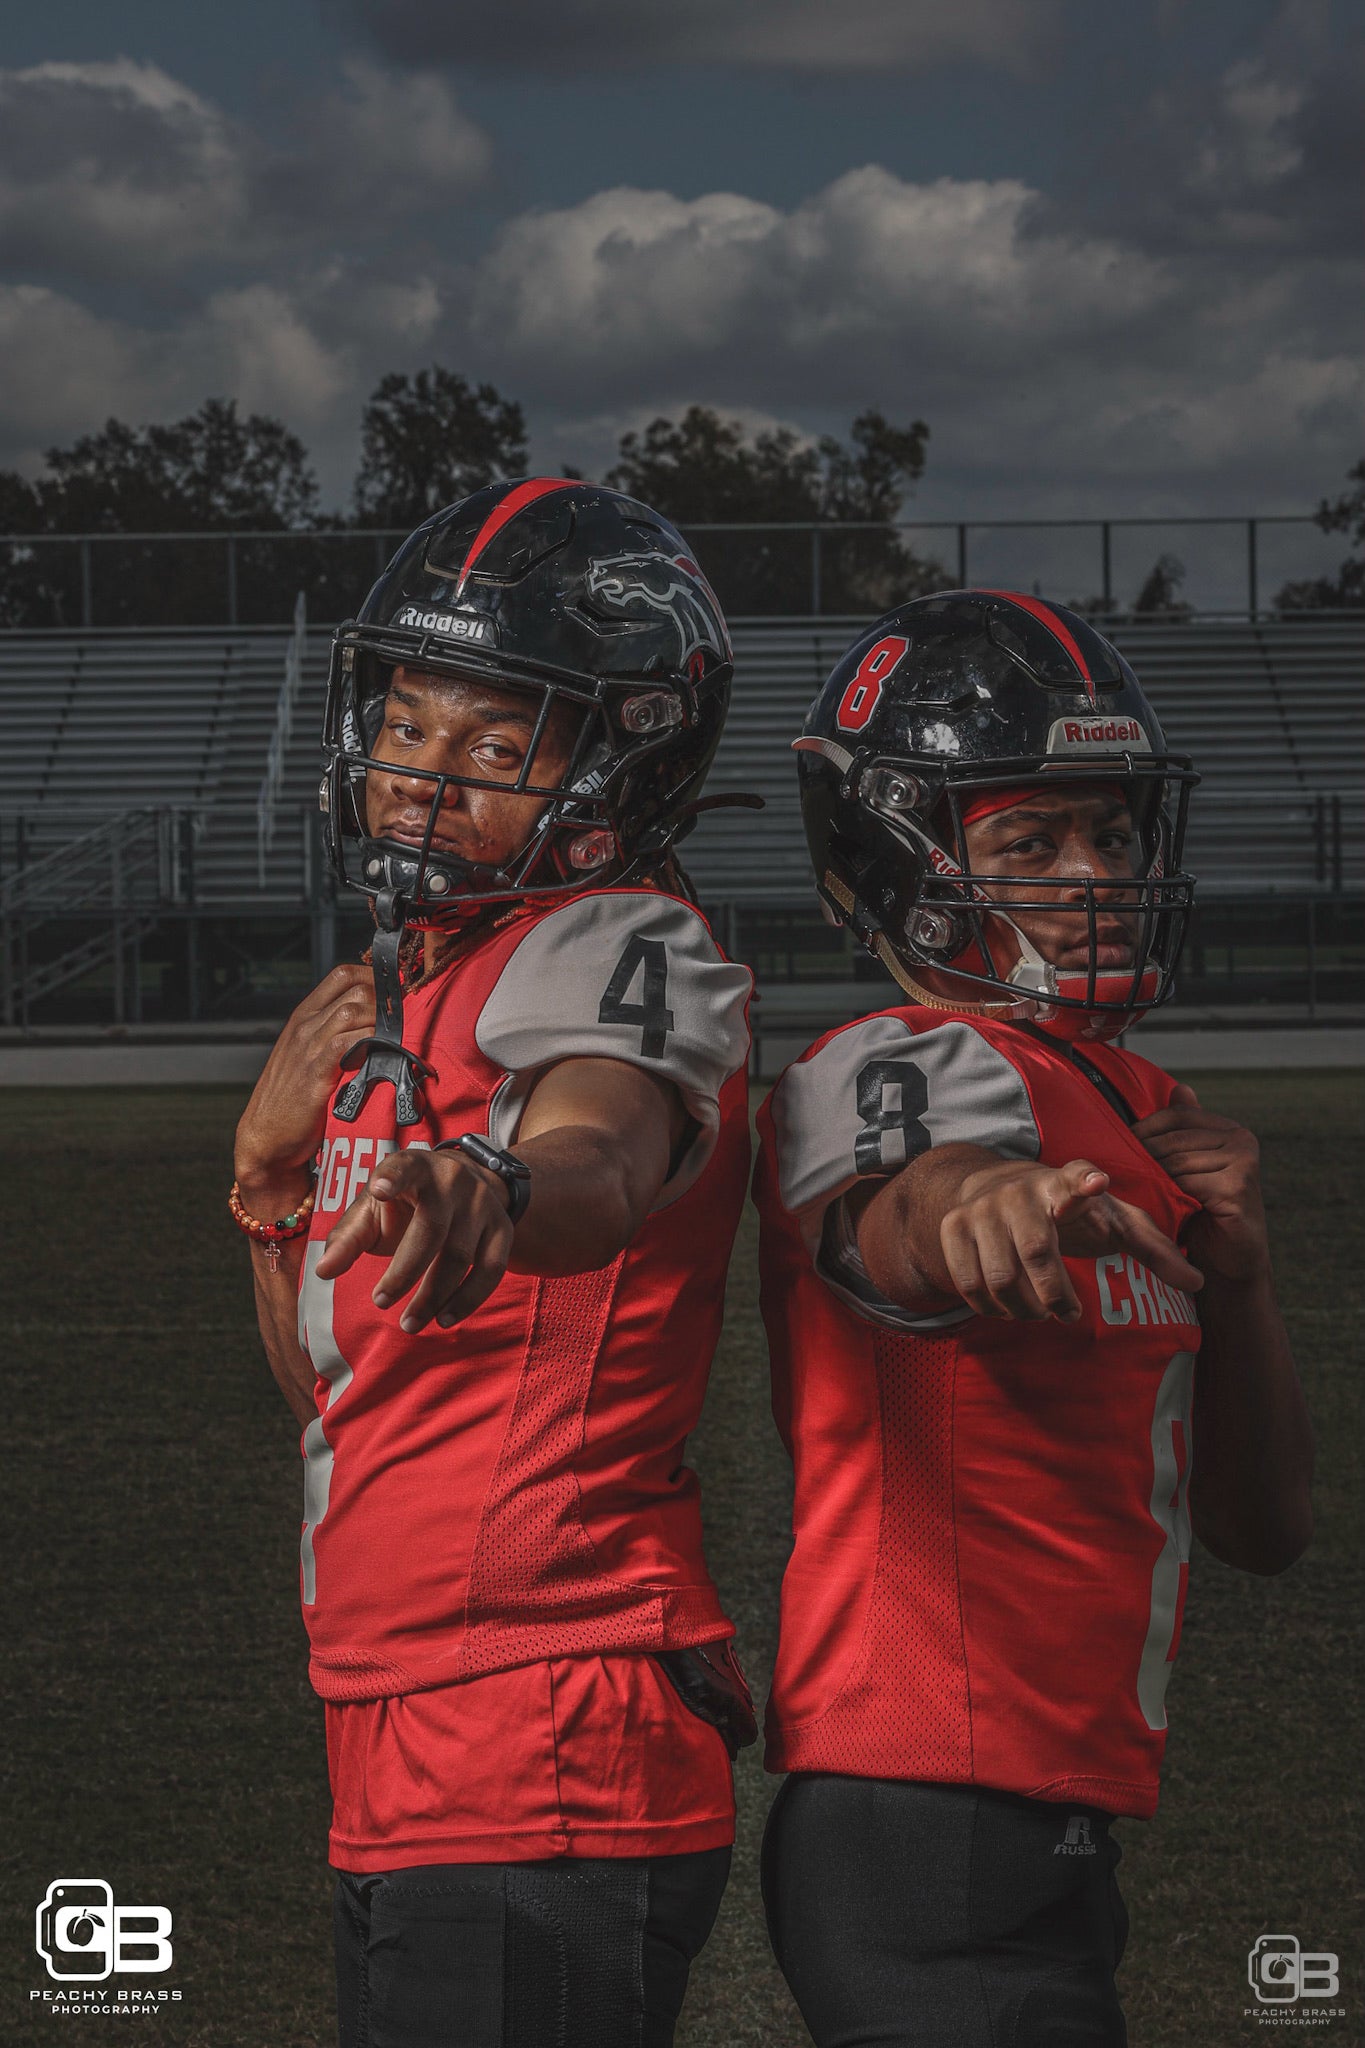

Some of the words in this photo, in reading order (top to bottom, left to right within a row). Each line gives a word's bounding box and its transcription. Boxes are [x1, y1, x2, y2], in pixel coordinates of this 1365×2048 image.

[399, 607, 485, 640] Riddell
[836, 635, 910, 734] 8
[342, 709, 367, 777] Riddll
[1062, 720, 1141, 743] Riddell
[598, 934, 674, 1060] 4
[854, 1060, 932, 1177] 8
